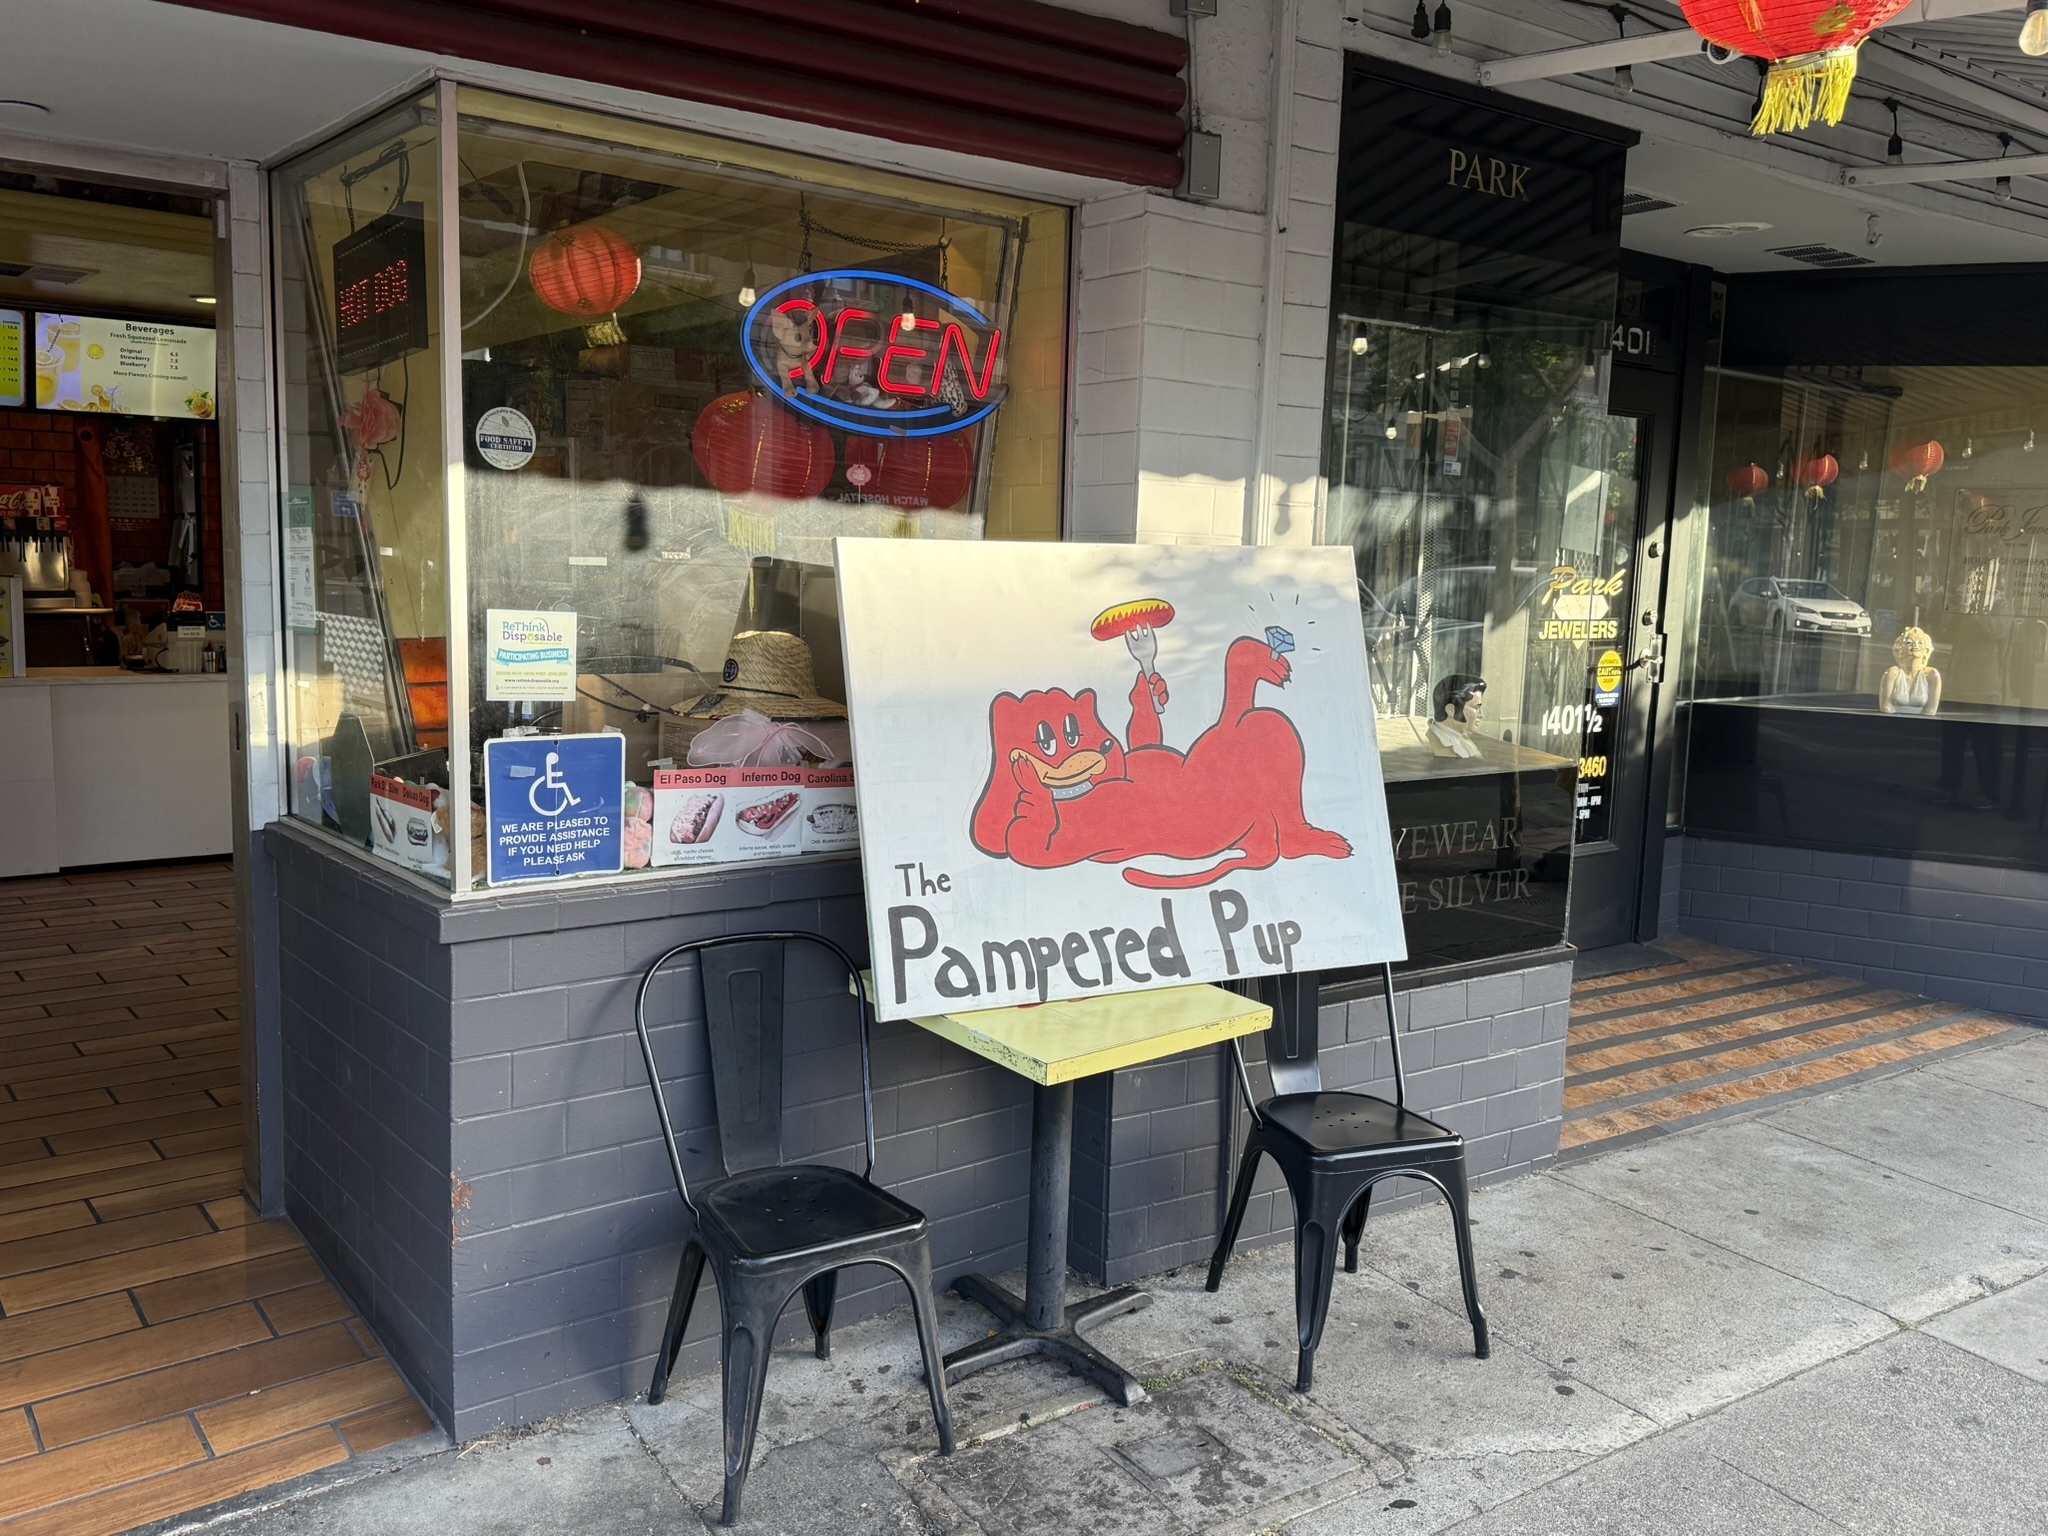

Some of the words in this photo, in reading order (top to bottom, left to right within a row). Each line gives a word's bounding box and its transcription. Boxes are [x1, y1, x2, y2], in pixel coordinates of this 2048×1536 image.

[1447, 148, 1531, 202] PARK
[340, 279, 368, 329] HOT
[374, 260, 408, 314] DOG
[125, 323, 175, 335] Beverages
[127, 334, 156, 342] Squeezed
[120, 354, 150, 362] Strawberry
[768, 299, 1001, 400] OPEN
[480, 435, 501, 444] FOOD
[502, 436, 532, 447] SAFETY
[490, 443, 523, 451] CERTIFIED
[1964, 504, 2017, 534] Park
[1541, 566, 1626, 605] Park
[503, 621, 545, 631] ReThink
[1539, 620, 1618, 639] JEWELERS
[503, 631, 562, 643] Disposable
[499, 651, 539, 661] PARTICIPATING
[540, 650, 567, 659] BUSINESS
[660, 775, 671, 784] El
[674, 774, 702, 784] Paso
[705, 773, 727, 785] Dog
[742, 772, 777, 782] Inferno
[780, 771, 801, 783] Dog
[807, 773, 848, 783] Carolina
[402, 785, 419, 801] Deluxe
[419, 792, 429, 807] Dog
[502, 824, 518, 834] WE
[521, 822, 544, 832] ARE
[547, 817, 591, 831] PLEASED
[593, 816, 608, 825] TO
[500, 833, 546, 846] PROVIDE
[549, 828, 610, 842] ASSISTANCE
[508, 847, 518, 856] IF
[520, 844, 544, 855] YOU
[547, 842, 572, 853] NEED
[574, 839, 600, 849] HELP
[523, 855, 564, 866] PLEASE
[566, 852, 585, 862] ASK
[894, 863, 951, 897] The
[1428, 868, 1532, 912] SILVER
[887, 898, 1191, 1002] Pampered
[1209, 889, 1302, 972] Pup
